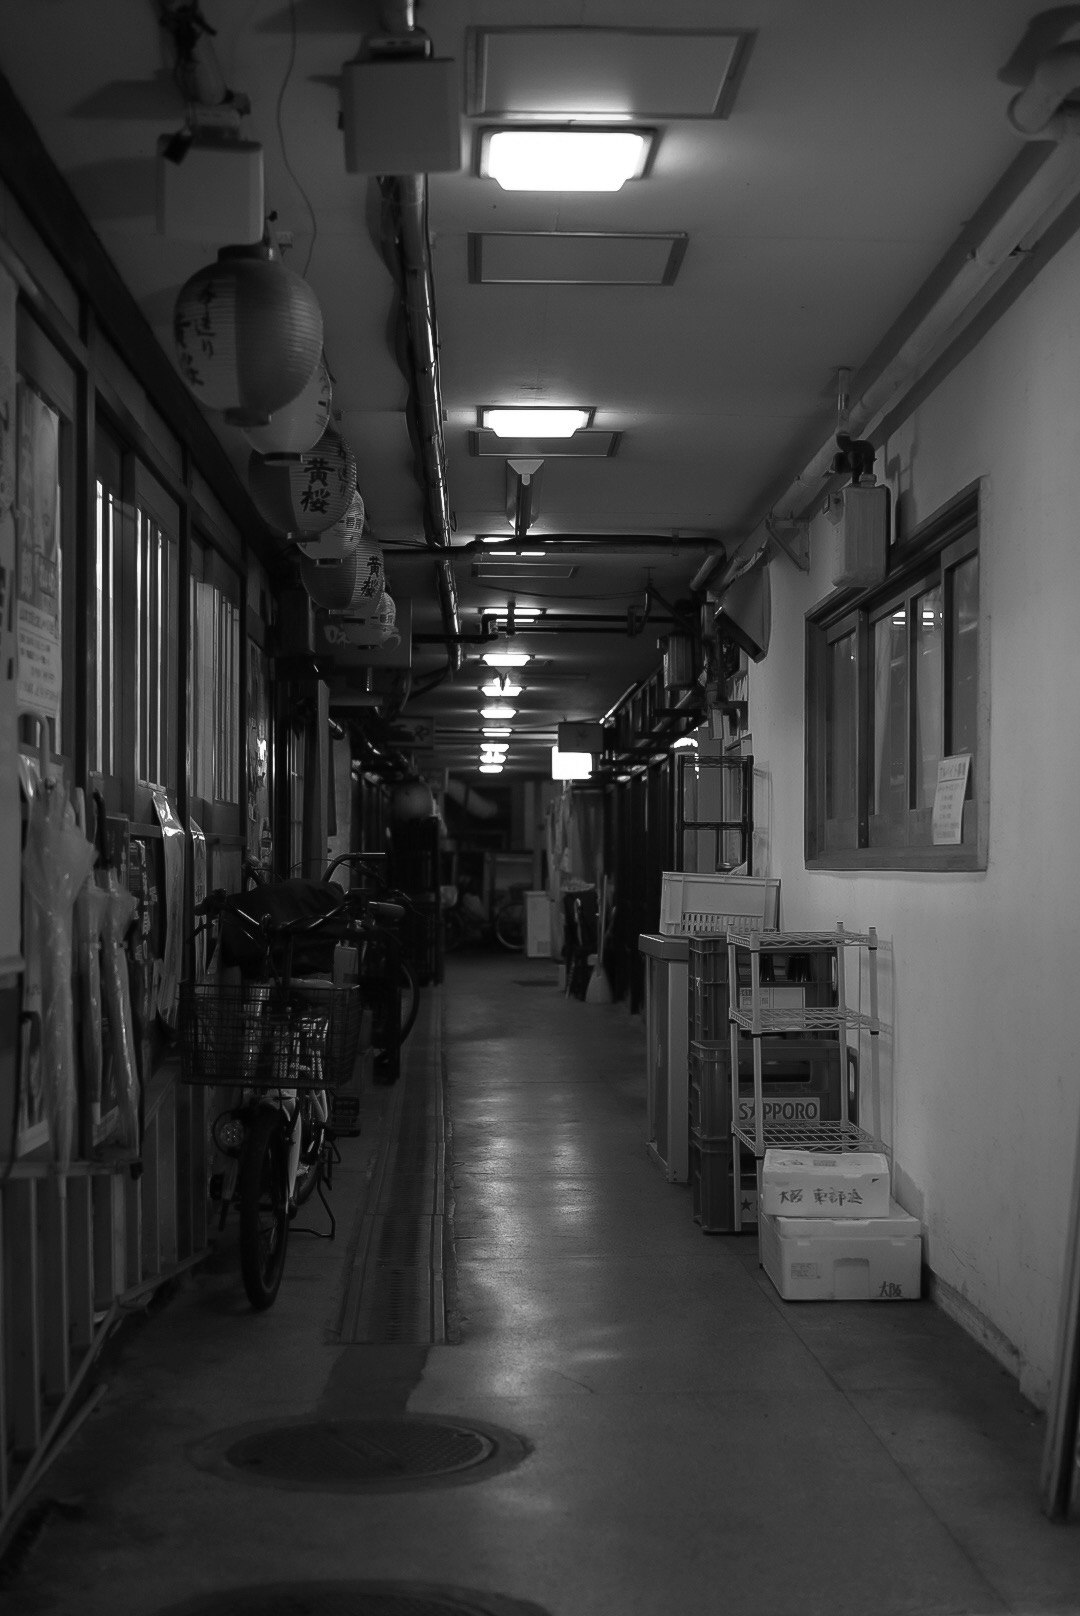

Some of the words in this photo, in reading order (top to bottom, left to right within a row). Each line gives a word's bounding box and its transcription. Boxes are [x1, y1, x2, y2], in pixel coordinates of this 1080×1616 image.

[301, 456, 336, 515] 黄桜
[360, 555, 382, 598] 黄桜
[878, 1280, 904, 1298] 大阪
